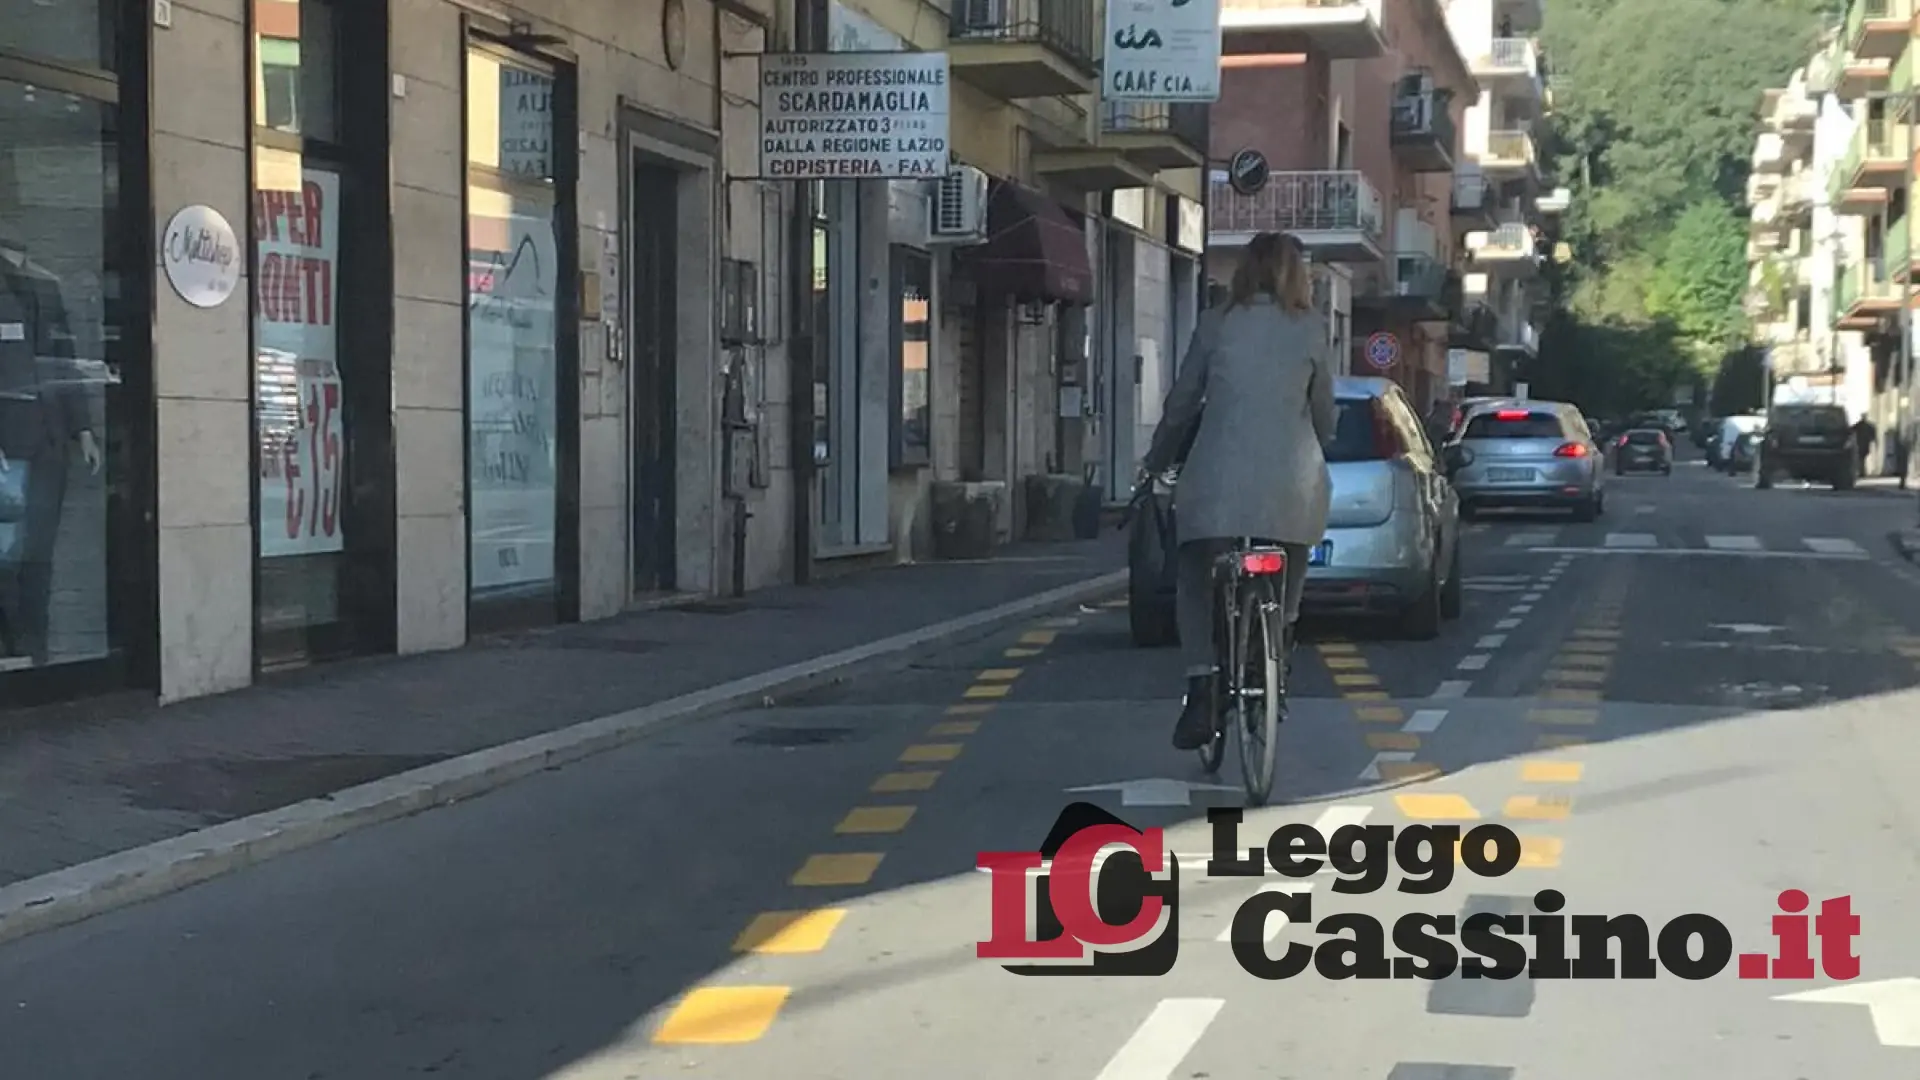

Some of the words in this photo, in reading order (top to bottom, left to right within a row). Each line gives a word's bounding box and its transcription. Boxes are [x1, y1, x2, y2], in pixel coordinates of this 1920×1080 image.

[764, 69, 818, 86] CENTRO
[826, 69, 944, 86] PROFESSIONALE
[1113, 71, 1157, 92] CAAF
[1164, 76, 1192, 92] CIA
[779, 91, 930, 112] SCARDAMAGLIA
[765, 118, 878, 134] AUTORIZZATO
[765, 138, 815, 154] DALLA
[823, 138, 891, 153] REGIONE
[898, 138, 944, 151] LAZIO
[770, 159, 883, 175] COPISTERIA
[899, 159, 936, 174] FAX
[256, 252, 332, 325] ONTI
